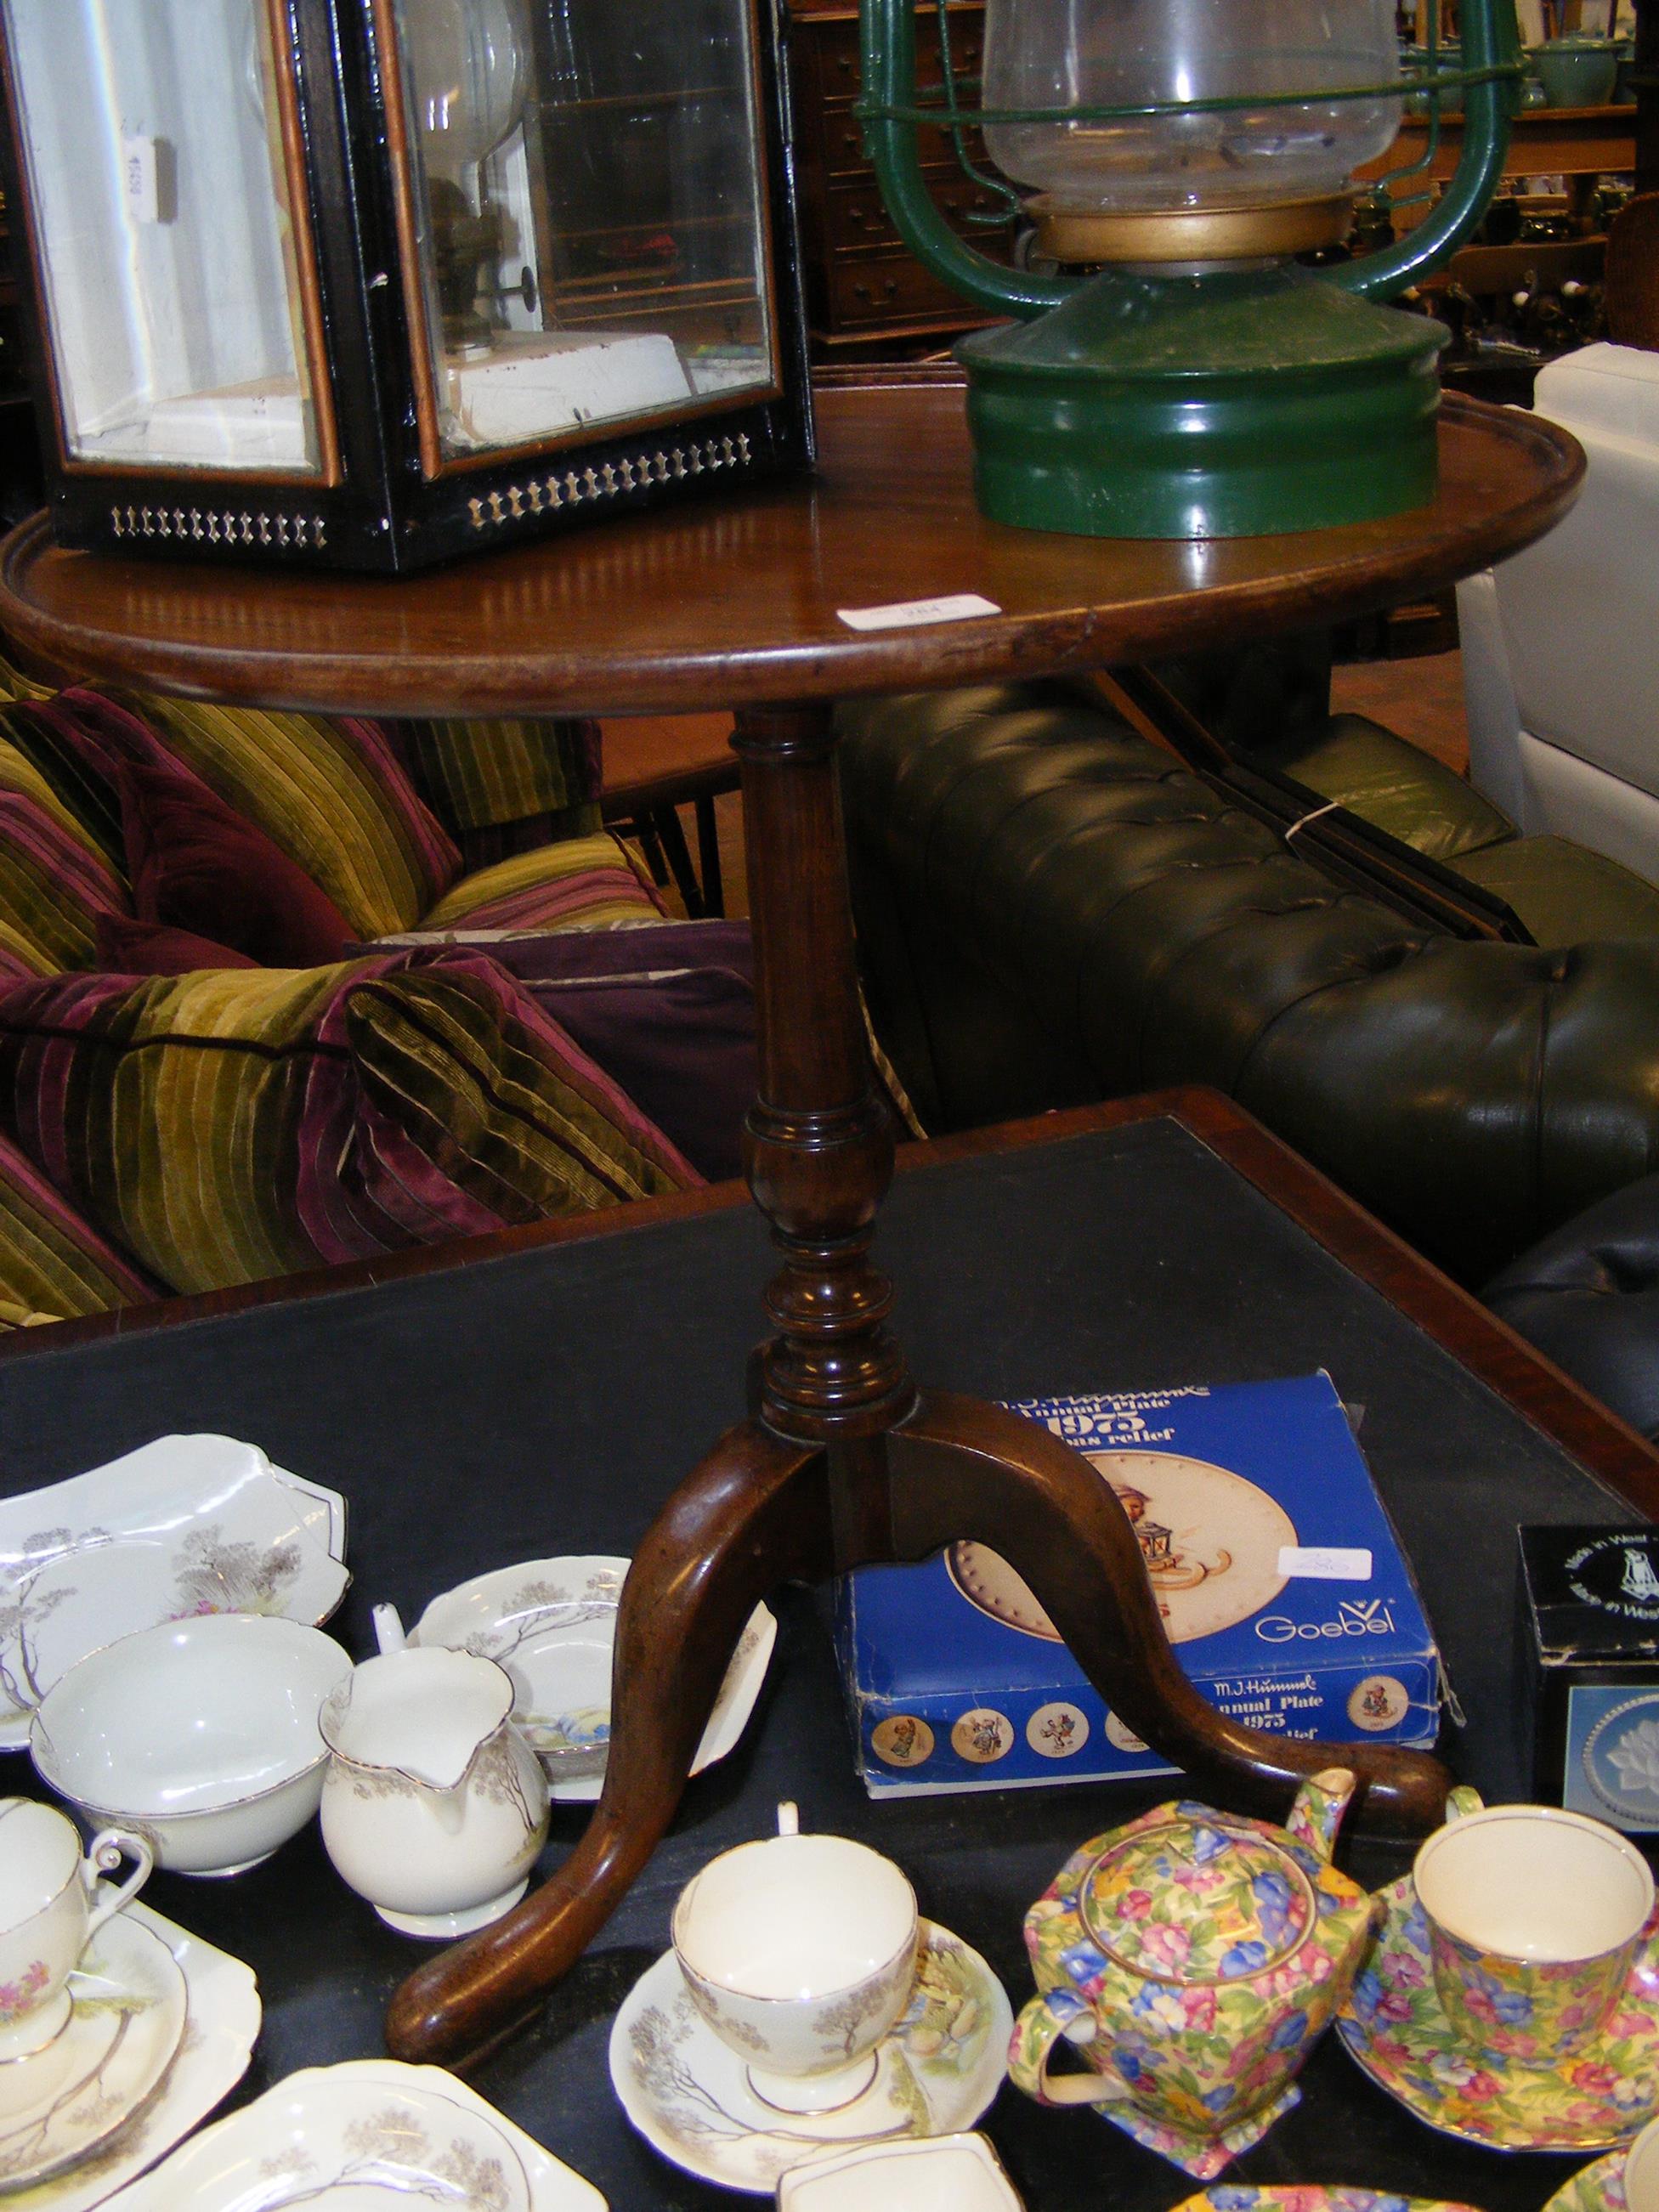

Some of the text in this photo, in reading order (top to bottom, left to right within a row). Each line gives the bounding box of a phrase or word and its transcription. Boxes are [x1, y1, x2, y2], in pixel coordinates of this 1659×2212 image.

[1113, 1396, 1171, 1411] Plate
[1047, 1410, 1146, 1437] 1975
[1107, 1428, 1175, 1445] relief
[1254, 1605, 1396, 1643] Goebel
[1216, 1695, 1324, 1714] nnual Plate
[1243, 1712, 1286, 1729] 1975
